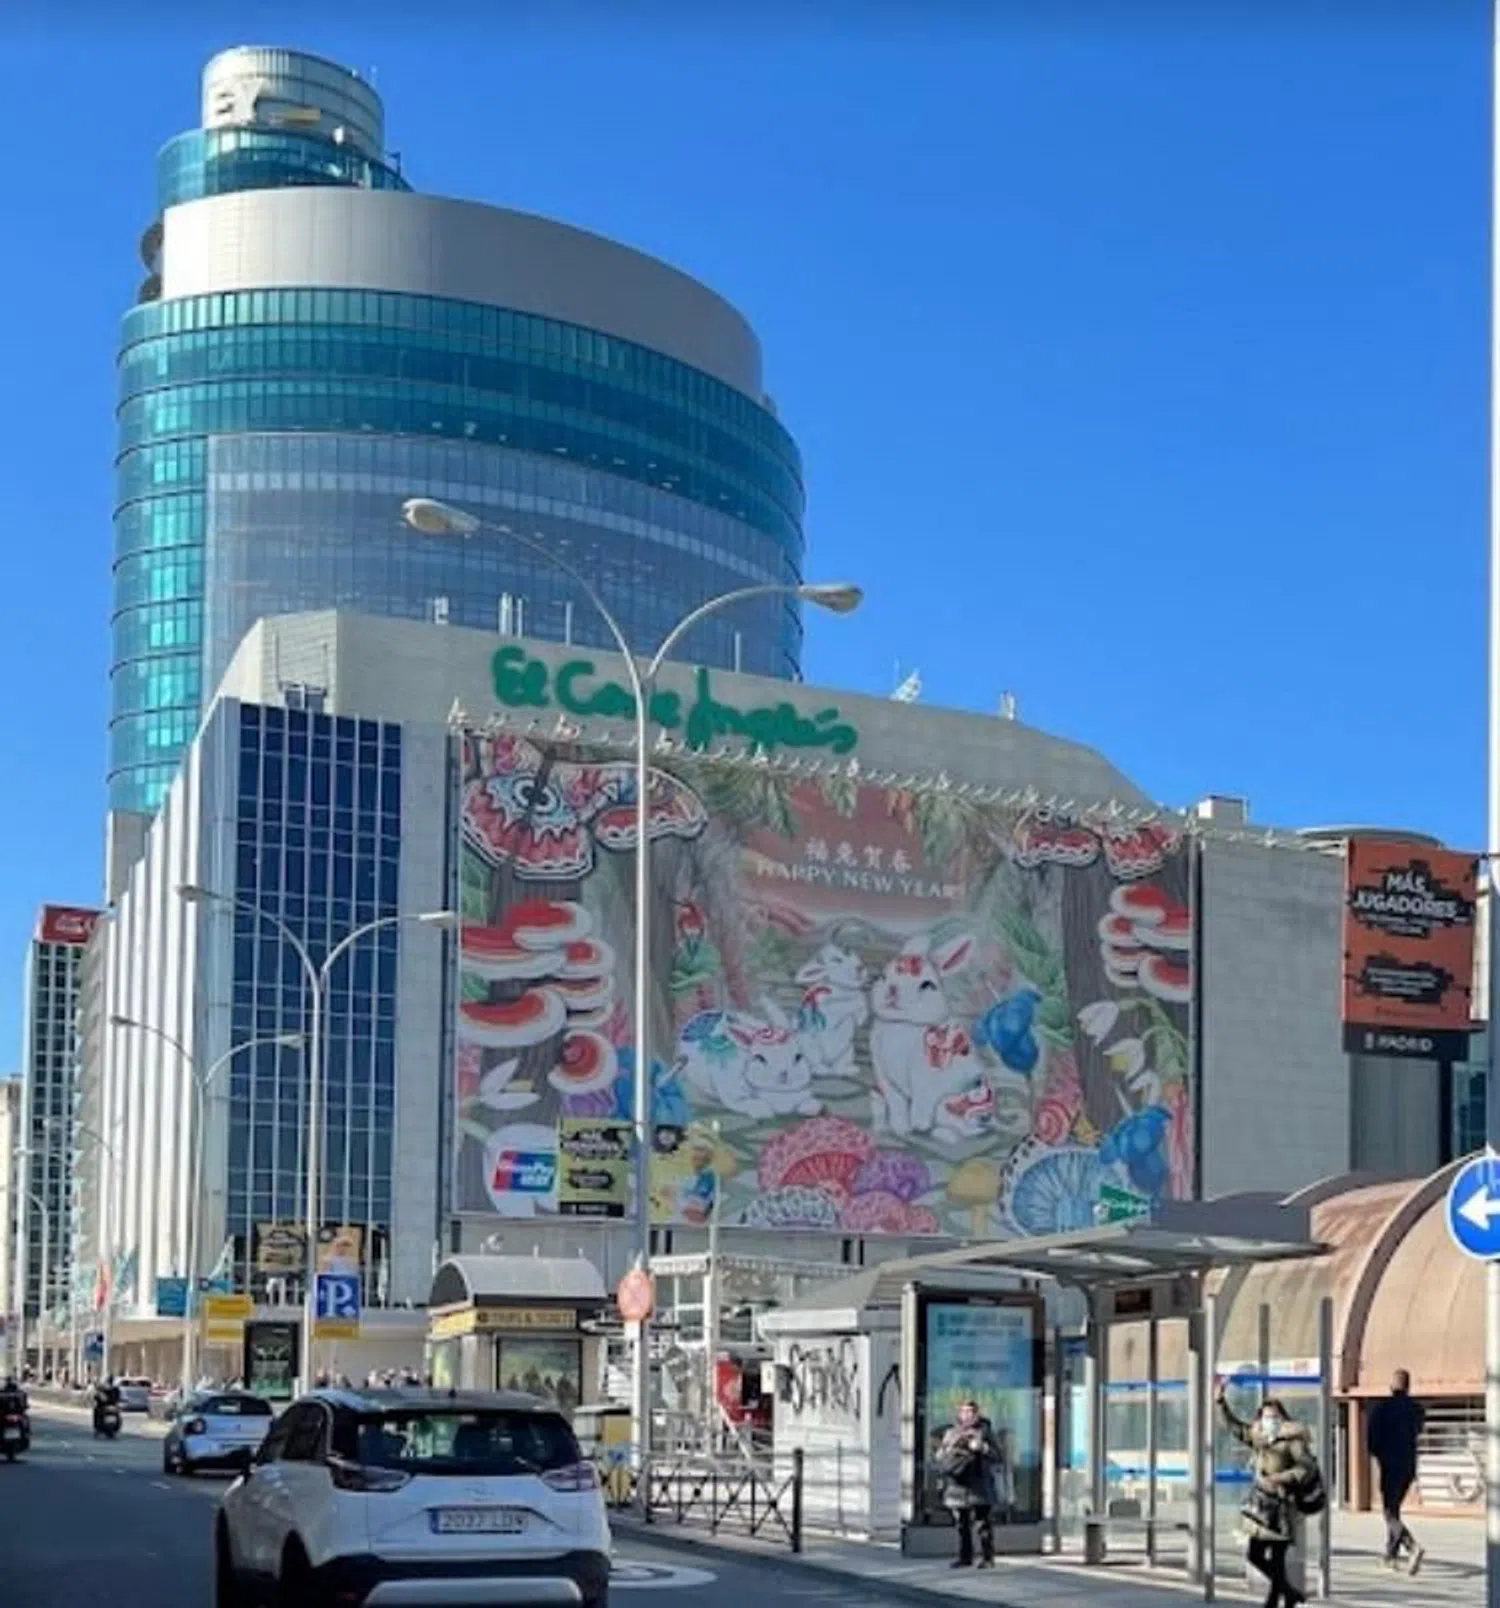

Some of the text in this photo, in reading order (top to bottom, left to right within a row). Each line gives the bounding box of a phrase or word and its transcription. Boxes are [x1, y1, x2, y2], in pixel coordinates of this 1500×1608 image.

[491, 645, 549, 707] El
[843, 870, 894, 893] NEW
[1353, 890, 1458, 917] JUGADORES
[325, 1279, 353, 1318] P
